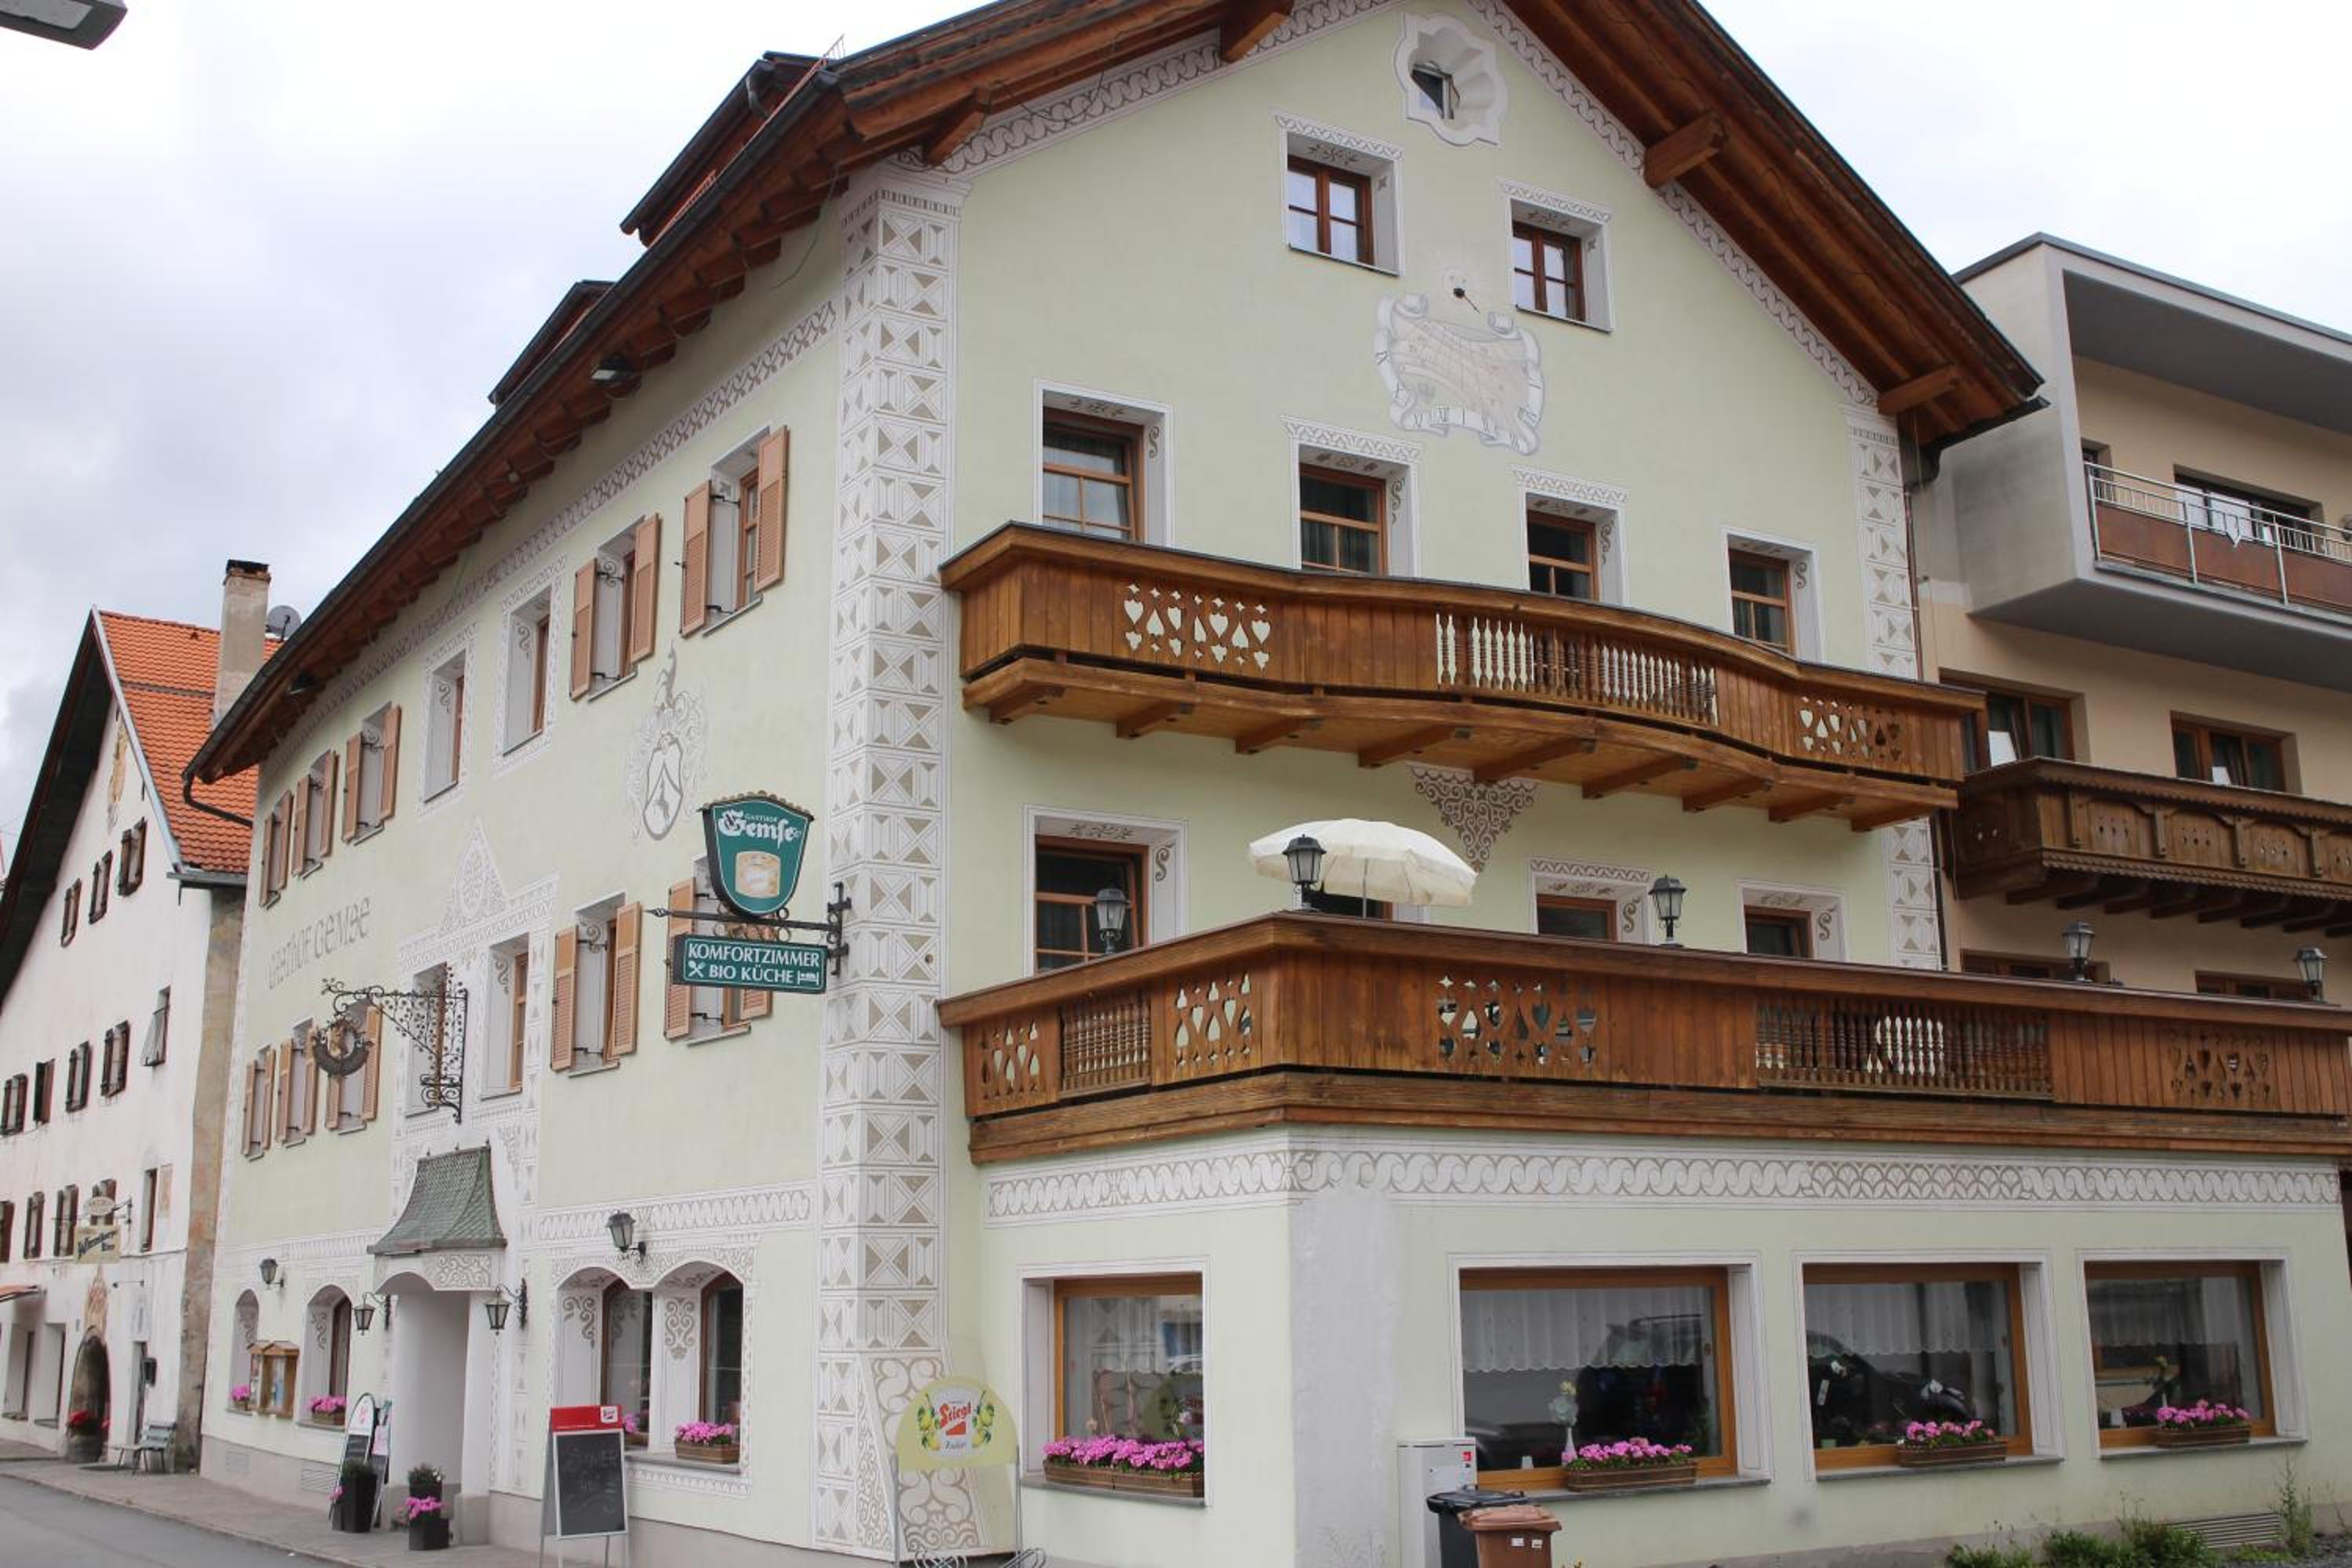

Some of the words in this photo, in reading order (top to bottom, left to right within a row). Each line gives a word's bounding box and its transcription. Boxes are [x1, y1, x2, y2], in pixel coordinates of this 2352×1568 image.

[688, 943, 820, 967] KOMFORTZIMMER
[709, 964, 737, 980] BIO
[741, 964, 794, 985] KÜCHE
